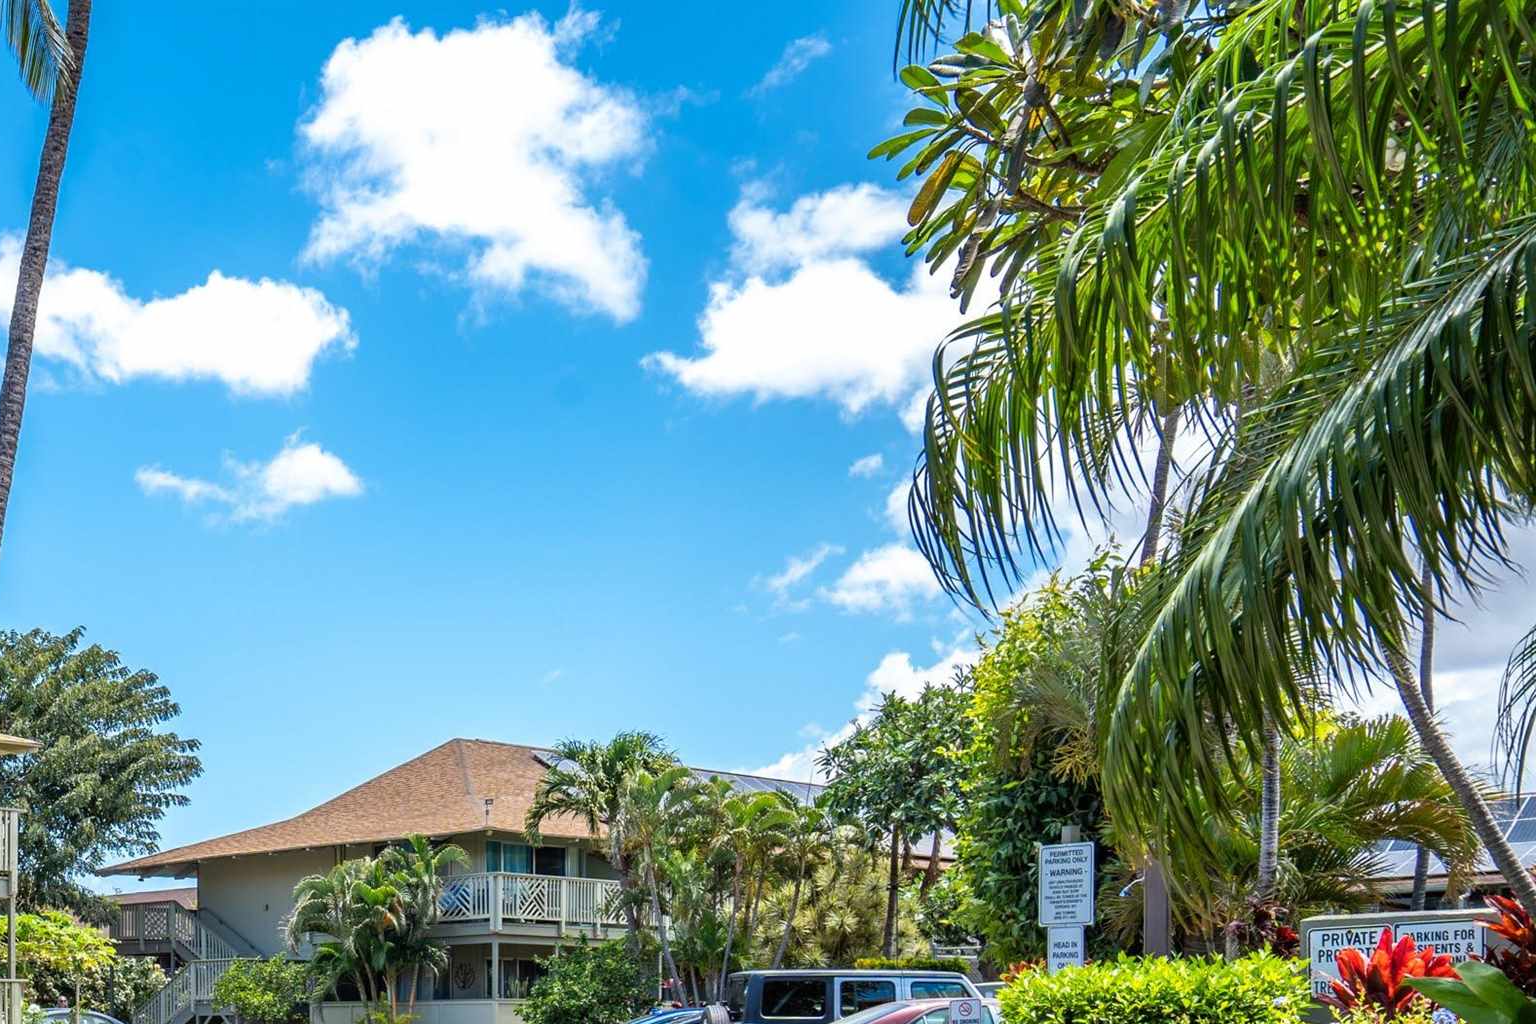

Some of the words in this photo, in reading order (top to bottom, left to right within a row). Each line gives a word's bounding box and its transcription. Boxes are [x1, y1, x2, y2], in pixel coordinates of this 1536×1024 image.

[1049, 849, 1083, 857] PERMITTED
[1072, 856, 1088, 864] ONLY
[1049, 867, 1083, 877] WARNING
[1321, 930, 1378, 946] PRIVATE
[1454, 929, 1475, 941] FOR
[1054, 941, 1070, 949] HEAD
[1052, 951, 1079, 959] PARKING
